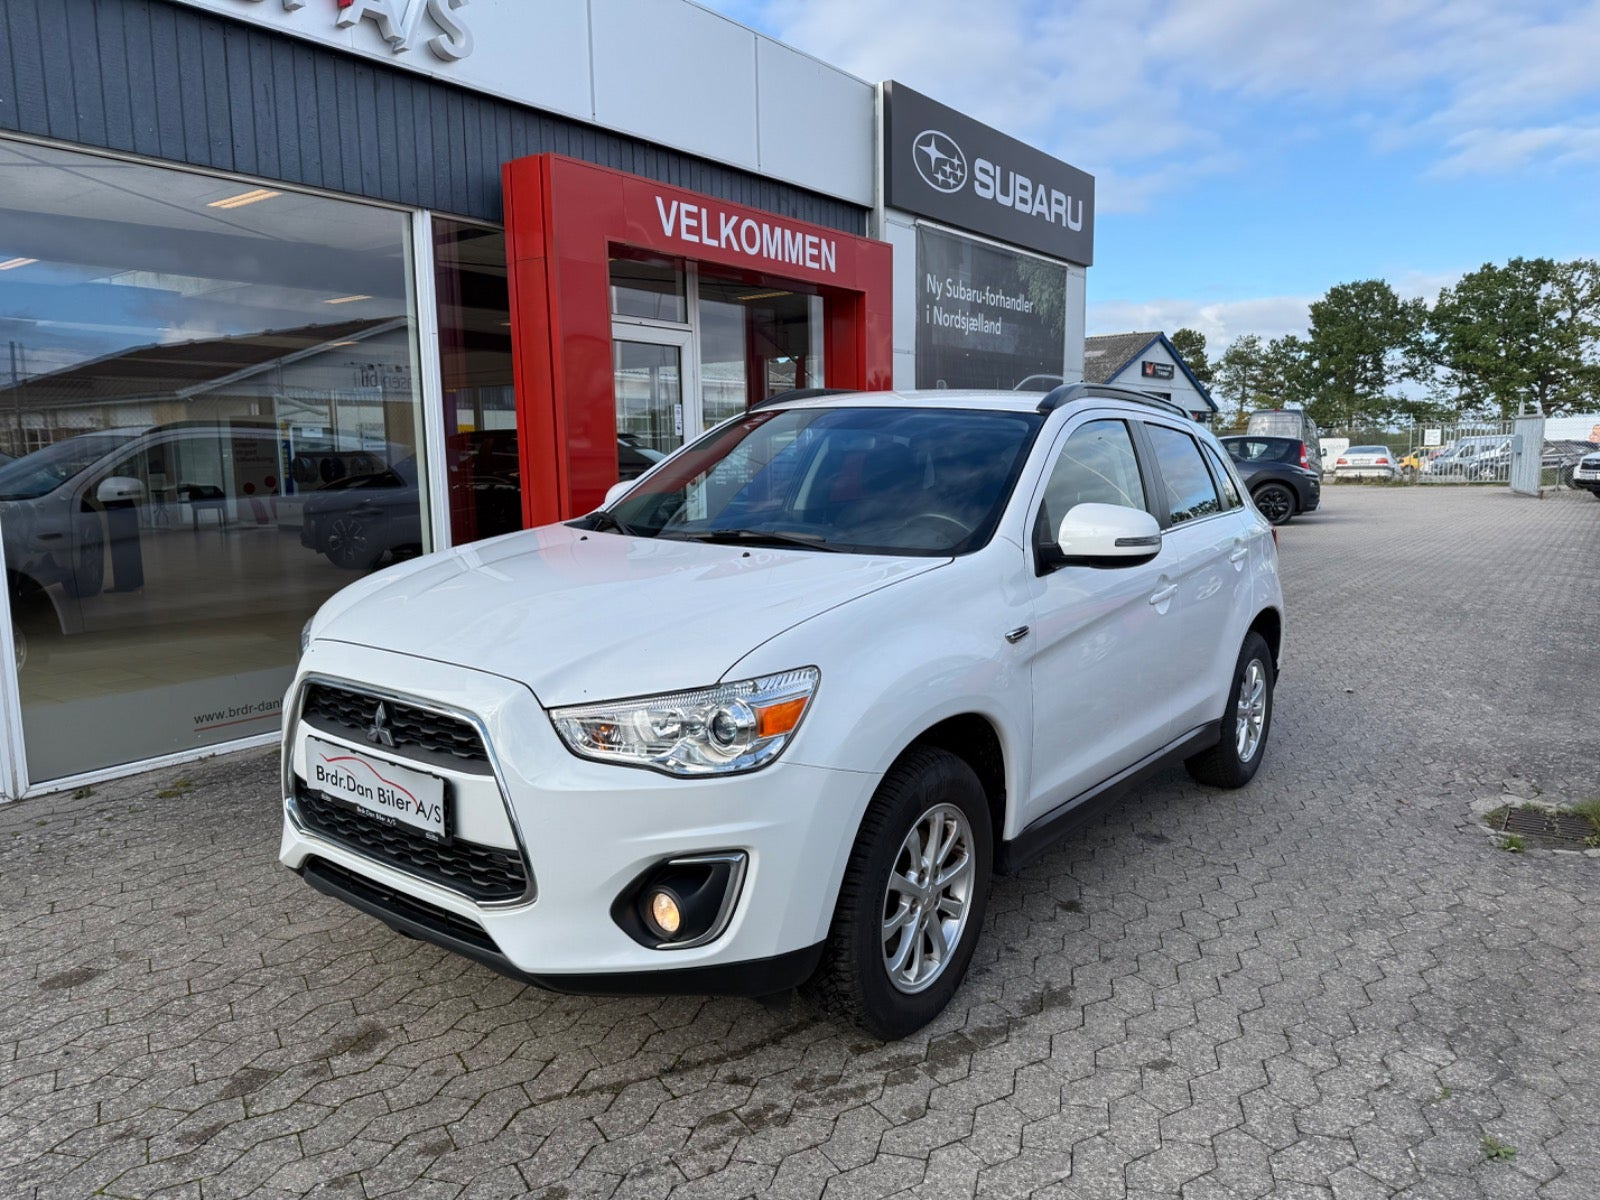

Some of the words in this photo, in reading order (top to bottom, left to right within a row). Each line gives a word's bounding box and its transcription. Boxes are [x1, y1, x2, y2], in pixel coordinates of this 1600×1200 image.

[974, 157, 1082, 232] SUBARU
[655, 196, 836, 273] VELKOMMEN
[926, 273, 943, 301] Ny
[945, 277, 1034, 313] Subaru-forhandler
[926, 304, 930, 324] i
[933, 305, 1002, 336] Nordsjælland
[316, 765, 374, 800] Brdr.Dan
[377, 787, 411, 812] Biler
[415, 799, 442, 824] A/S
